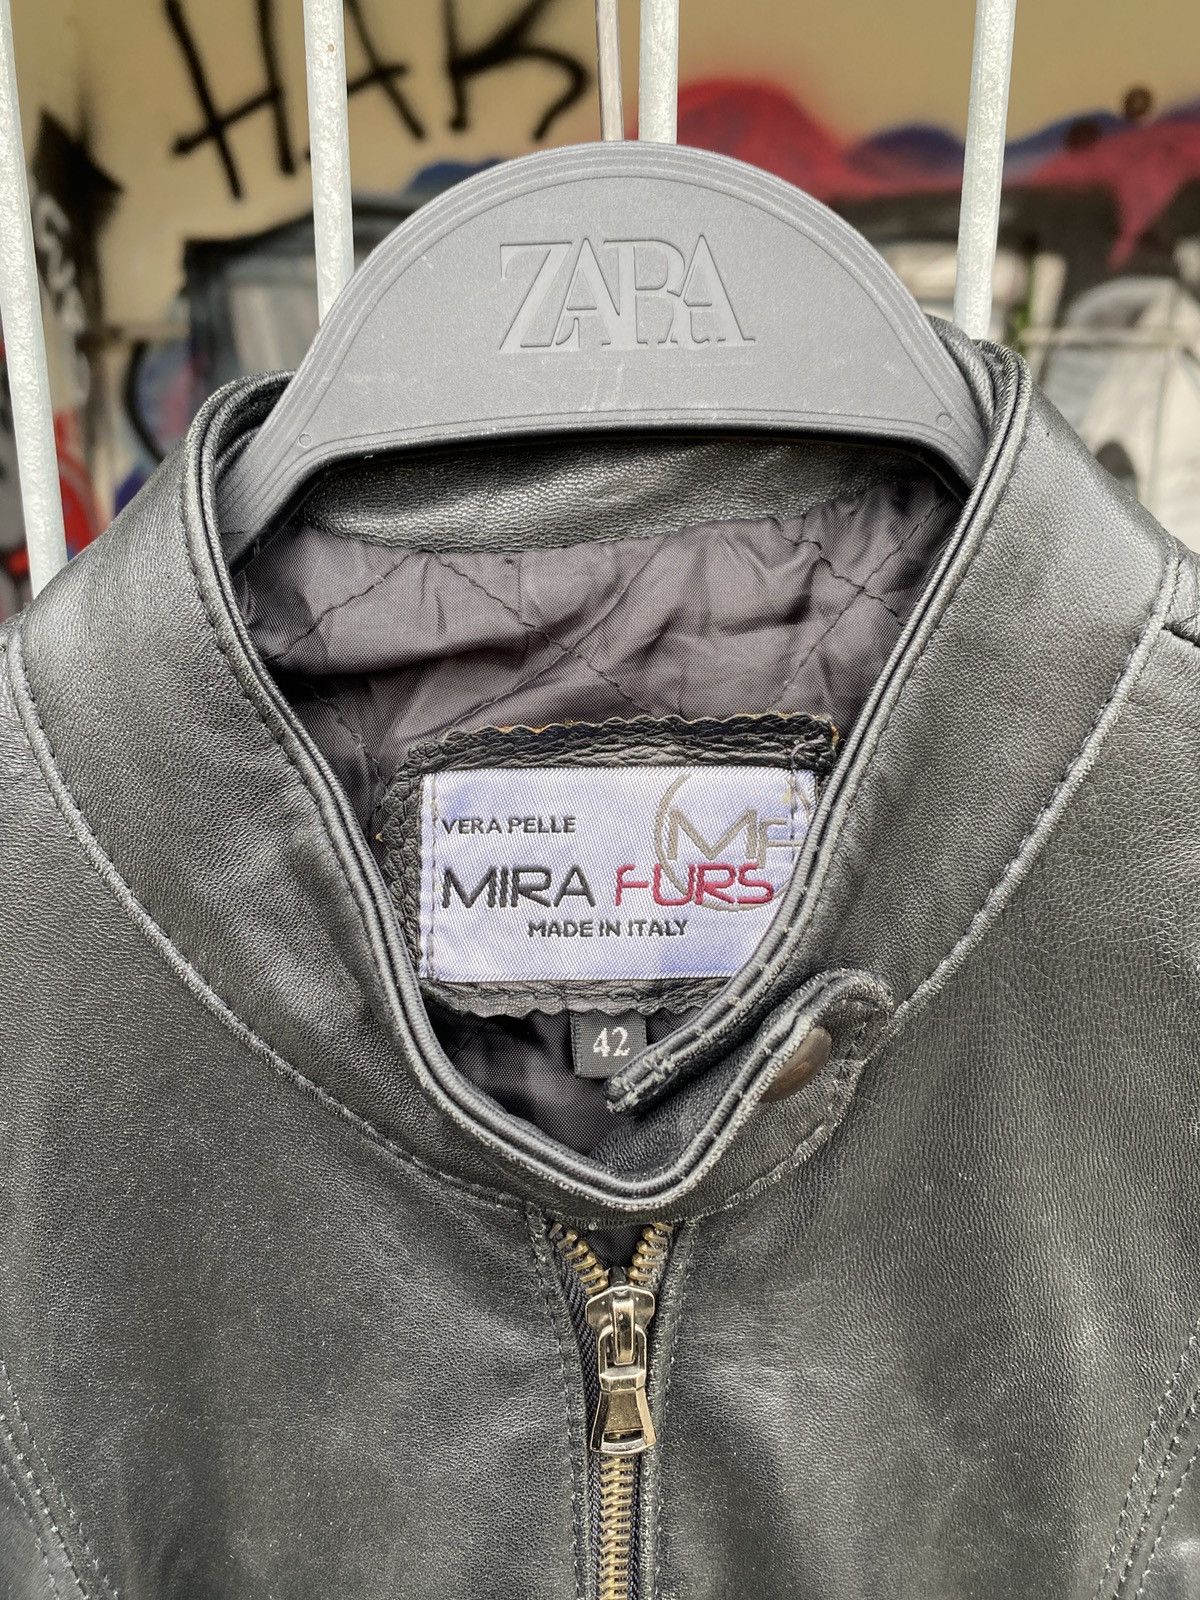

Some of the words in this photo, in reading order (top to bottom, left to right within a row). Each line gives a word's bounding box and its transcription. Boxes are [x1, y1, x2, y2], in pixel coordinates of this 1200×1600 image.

[499, 234, 756, 352] ZARA
[442, 817, 503, 835] VERA
[507, 815, 576, 834] PELLE
[441, 864, 597, 909] MIRA
[528, 920, 594, 938] MADE
[599, 919, 622, 937] IN
[627, 918, 688, 937] ITALY
[592, 1026, 631, 1058] 42
